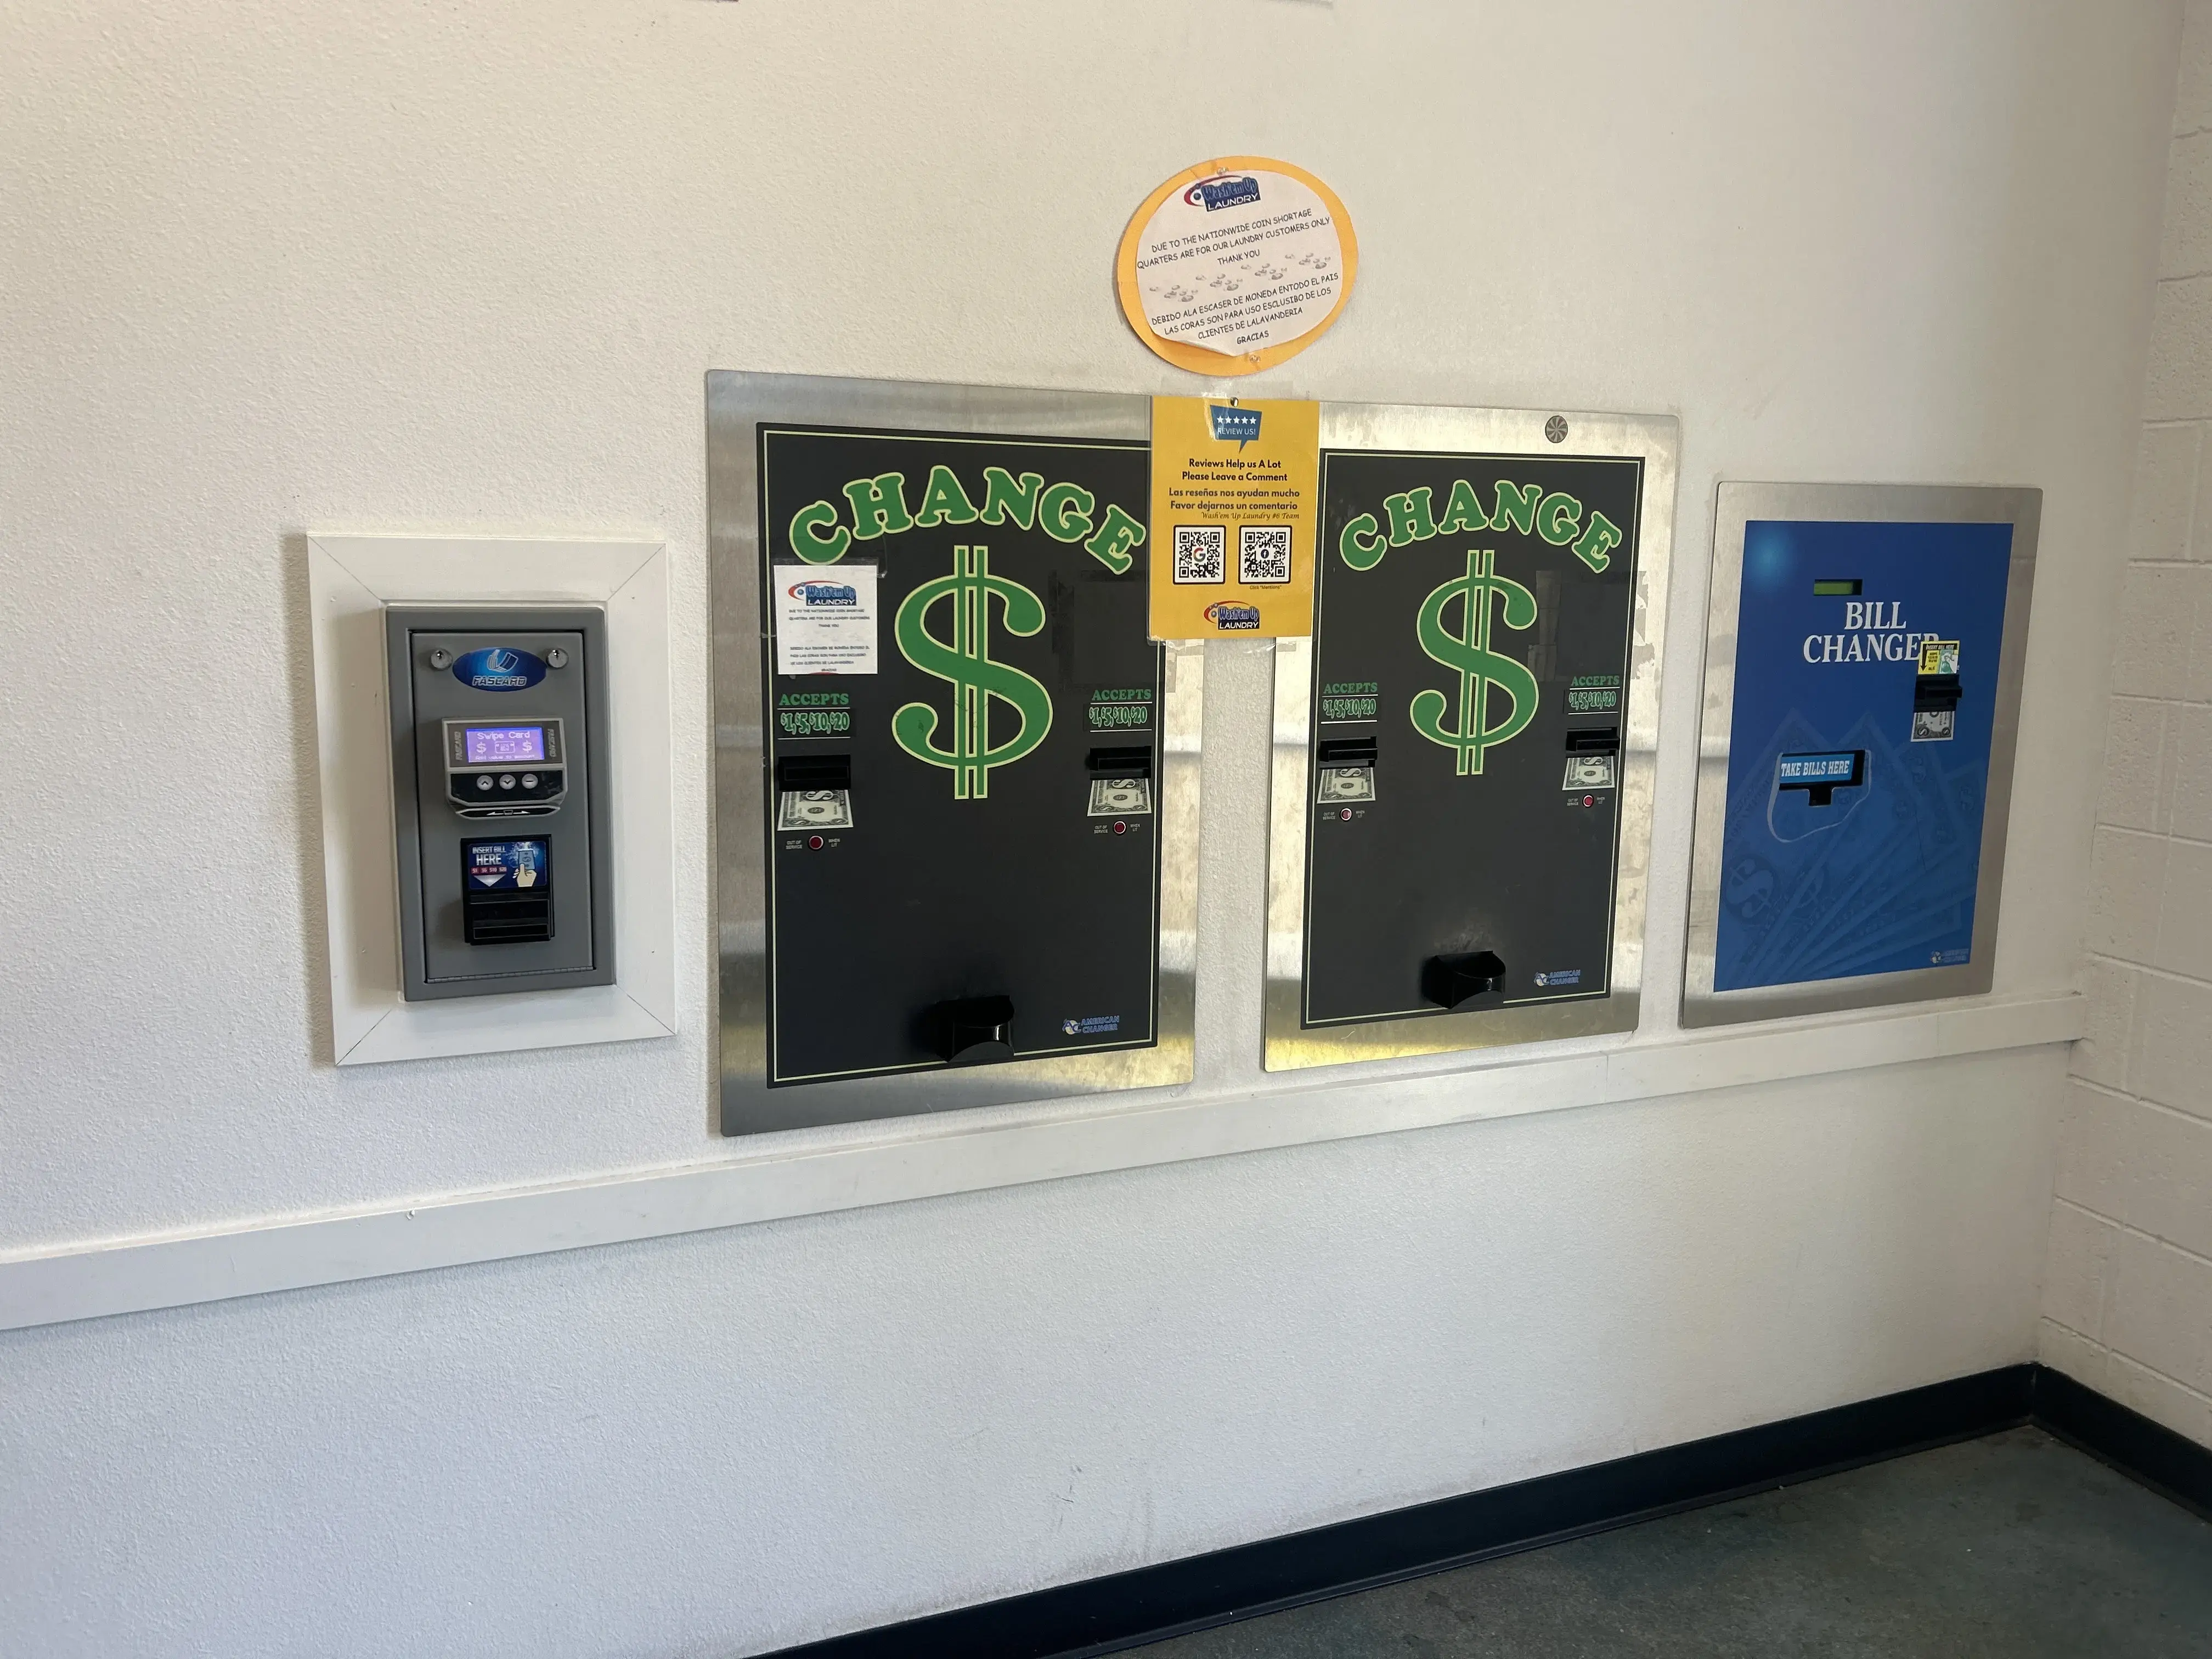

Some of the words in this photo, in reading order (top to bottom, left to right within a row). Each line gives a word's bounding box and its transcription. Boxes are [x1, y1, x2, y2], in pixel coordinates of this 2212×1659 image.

[1243, 177, 1257, 193] Up
[1208, 193, 1258, 210] LAUNDRY
[1152, 242, 1167, 253] DUE
[1169, 240, 1180, 248] TO
[1182, 235, 1197, 245] THE
[1198, 223, 1250, 242] NATIONWIDE
[1252, 218, 1271, 229] COIN
[1273, 208, 1312, 224] SHORTAGE
[1137, 253, 1178, 269] QUARTERS
[1181, 249, 1194, 259] ARE
[1196, 245, 1211, 256] FOR
[1212, 241, 1228, 251] OUR
[1230, 233, 1263, 247] LAUNDRY
[1266, 222, 1309, 239] CUSTOMERS
[1311, 217, 1330, 228] ONLY
[1217, 253, 1243, 265] THANK
[1244, 249, 1260, 258] YOU
[1152, 312, 1181, 325] DEBIDO
[1183, 308, 1197, 318] ALA
[1199, 299, 1232, 313] ESCASER
[1233, 296, 1243, 305] DE
[1245, 288, 1277, 302] MONEDA
[1279, 280, 1310, 294] ENTODO
[1311, 278, 1319, 286] EL
[1321, 273, 1339, 283] PAIS
[1164, 325, 1179, 335] LAS
[1181, 319, 1205, 331] CORAS
[1207, 314, 1223, 324] SON
[1224, 309, 1244, 320] PARA
[1245, 304, 1261, 314] USO
[1263, 294, 1304, 311] ESCLUSIBO
[1305, 290, 1315, 300] DE
[1317, 287, 1331, 297] LOS
[1198, 324, 1233, 339] CLIENTES
[1235, 320, 1245, 330] DE
[1246, 307, 1303, 328] LALAVANDERIA
[1237, 330, 1269, 345] GRACIAS
[1189, 458, 1224, 467] Reviews
[1226, 459, 1245, 470] Help
[1259, 459, 1265, 468] A
[1267, 459, 1281, 468] Lot
[1182, 470, 1209, 480] Please
[1211, 472, 1236, 480] Leave
[1246, 472, 1287, 481] Comment
[1169, 487, 1183, 496] Las
[1186, 488, 1218, 496] reseñas
[1237, 488, 1269, 499] ayudan
[1272, 488, 1300, 497] mucho
[1171, 500, 1195, 509] Favor
[1198, 500, 1234, 511] dejarnos
[1249, 501, 1297, 509] comentario
[789, 465, 1146, 575] CHANGE
[1231, 512, 1240, 521] Up
[1242, 512, 1271, 521] Laundry
[1340, 479, 1622, 574] CHANGE
[844, 586, 856, 599] Up
[1249, 607, 1259, 622] Up
[1844, 601, 1906, 630] BILL
[1803, 633, 1939, 663] CHANGE
[472, 675, 527, 686] FASCARD
[1571, 675, 1620, 686] ACCEPTS
[1323, 682, 1378, 694] ACCEPTS
[779, 693, 849, 706] ACCEPTS
[1092, 689, 1152, 701] ACCEPTS
[477, 731, 504, 741] Swipe
[1781, 763, 1802, 777] TAKE
[1803, 761, 1826, 776] BILLS
[1827, 760, 1850, 775] HERE
[472, 846, 493, 854] INSERT
[476, 853, 502, 866] HERE
[1081, 1015, 1120, 1026] AMERICAN
[1082, 1024, 1118, 1034] CHANGER
